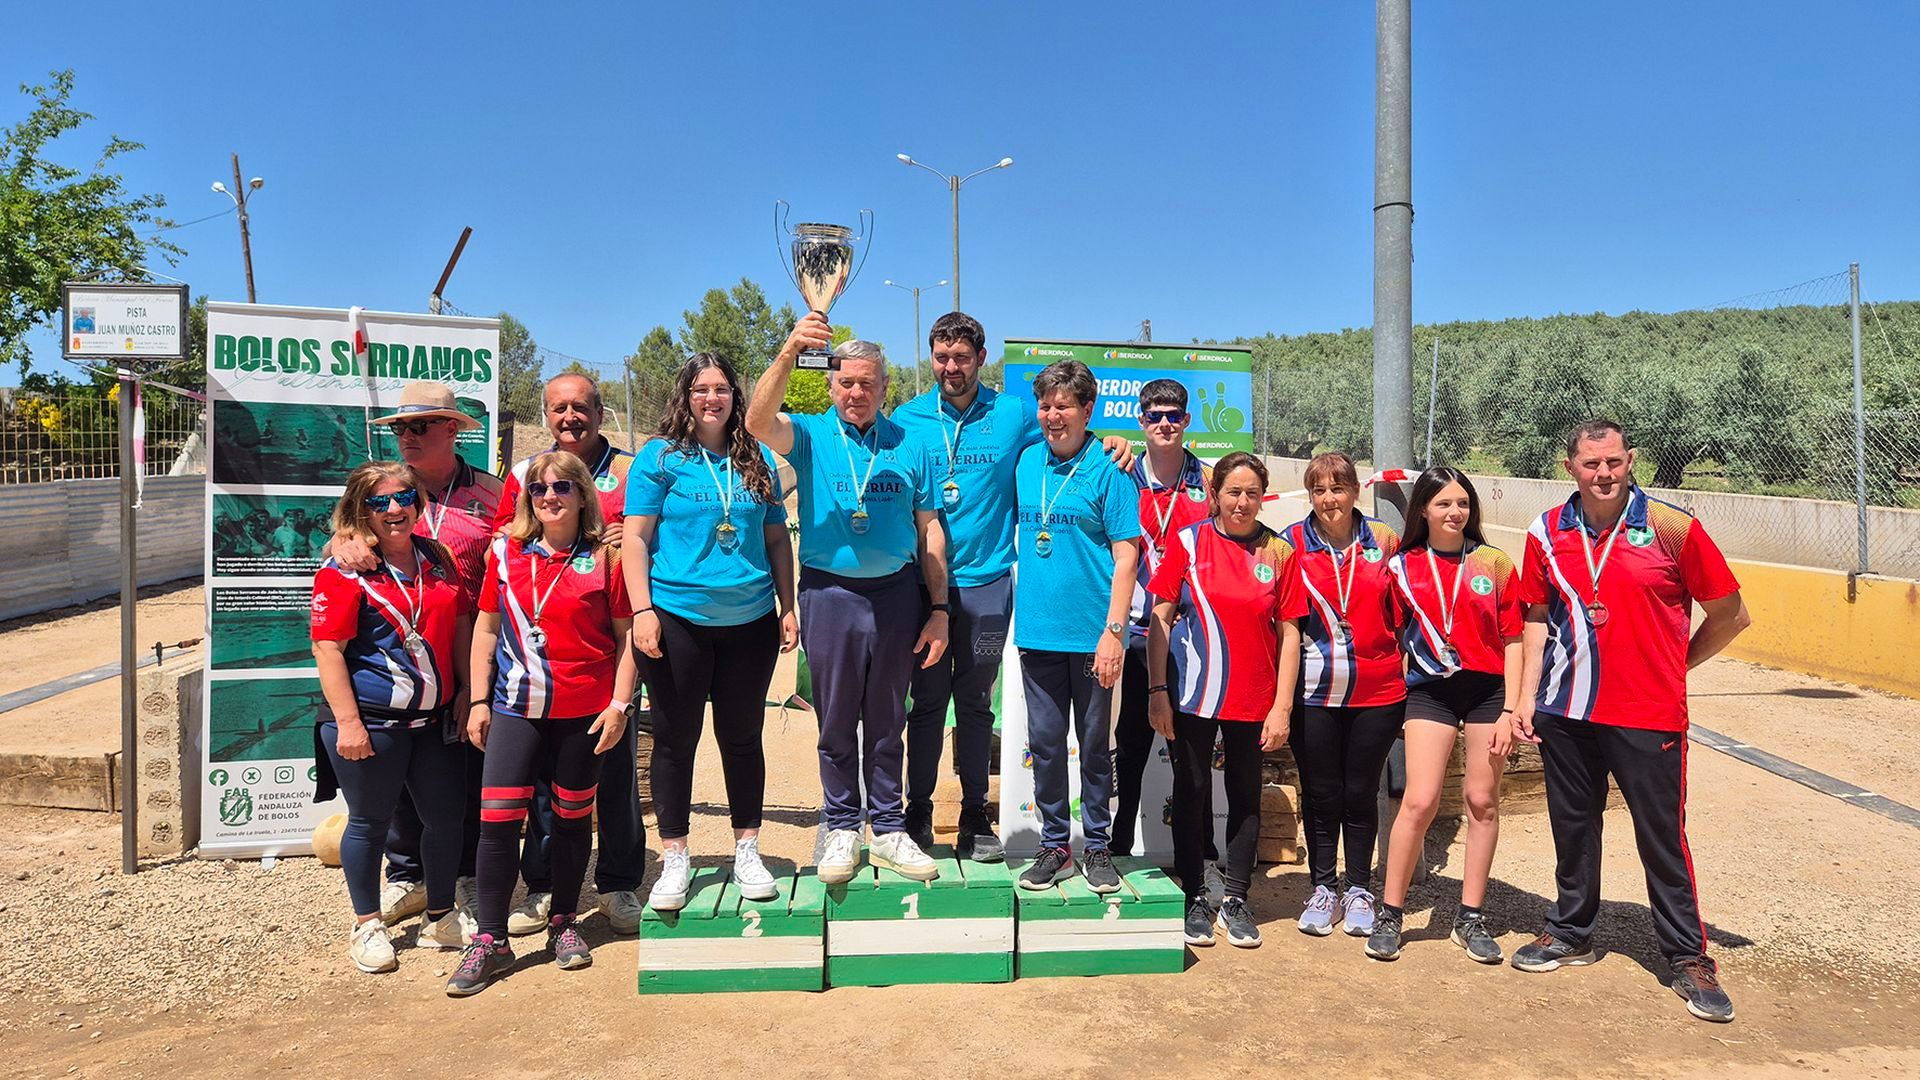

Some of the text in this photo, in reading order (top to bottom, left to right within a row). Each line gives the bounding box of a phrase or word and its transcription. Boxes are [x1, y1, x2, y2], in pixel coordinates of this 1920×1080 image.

[127, 307, 147, 318] PISTA
[98, 322, 176, 336] JUAN MUÑOZ CASTRO
[214, 334, 321, 375] BOLOS
[1038, 349, 1074, 357] IBERDROLA
[1197, 354, 1233, 363] IBERDROLA
[1103, 400, 1143, 418] BOLO
[1196, 441, 1234, 449] IBERDROLA
[1491, 487, 1504, 500] 20
[1034, 512, 1081, 526] FRIAL"
[224, 787, 249, 798] FAB
[258, 791, 312, 800] FEDERACIÓN
[258, 801, 303, 810] ANDALUZA
[271, 812, 300, 820] BOLOS
[900, 891, 920, 920] 1
[1102, 897, 1122, 921] 3
[740, 909, 764, 937] 2
